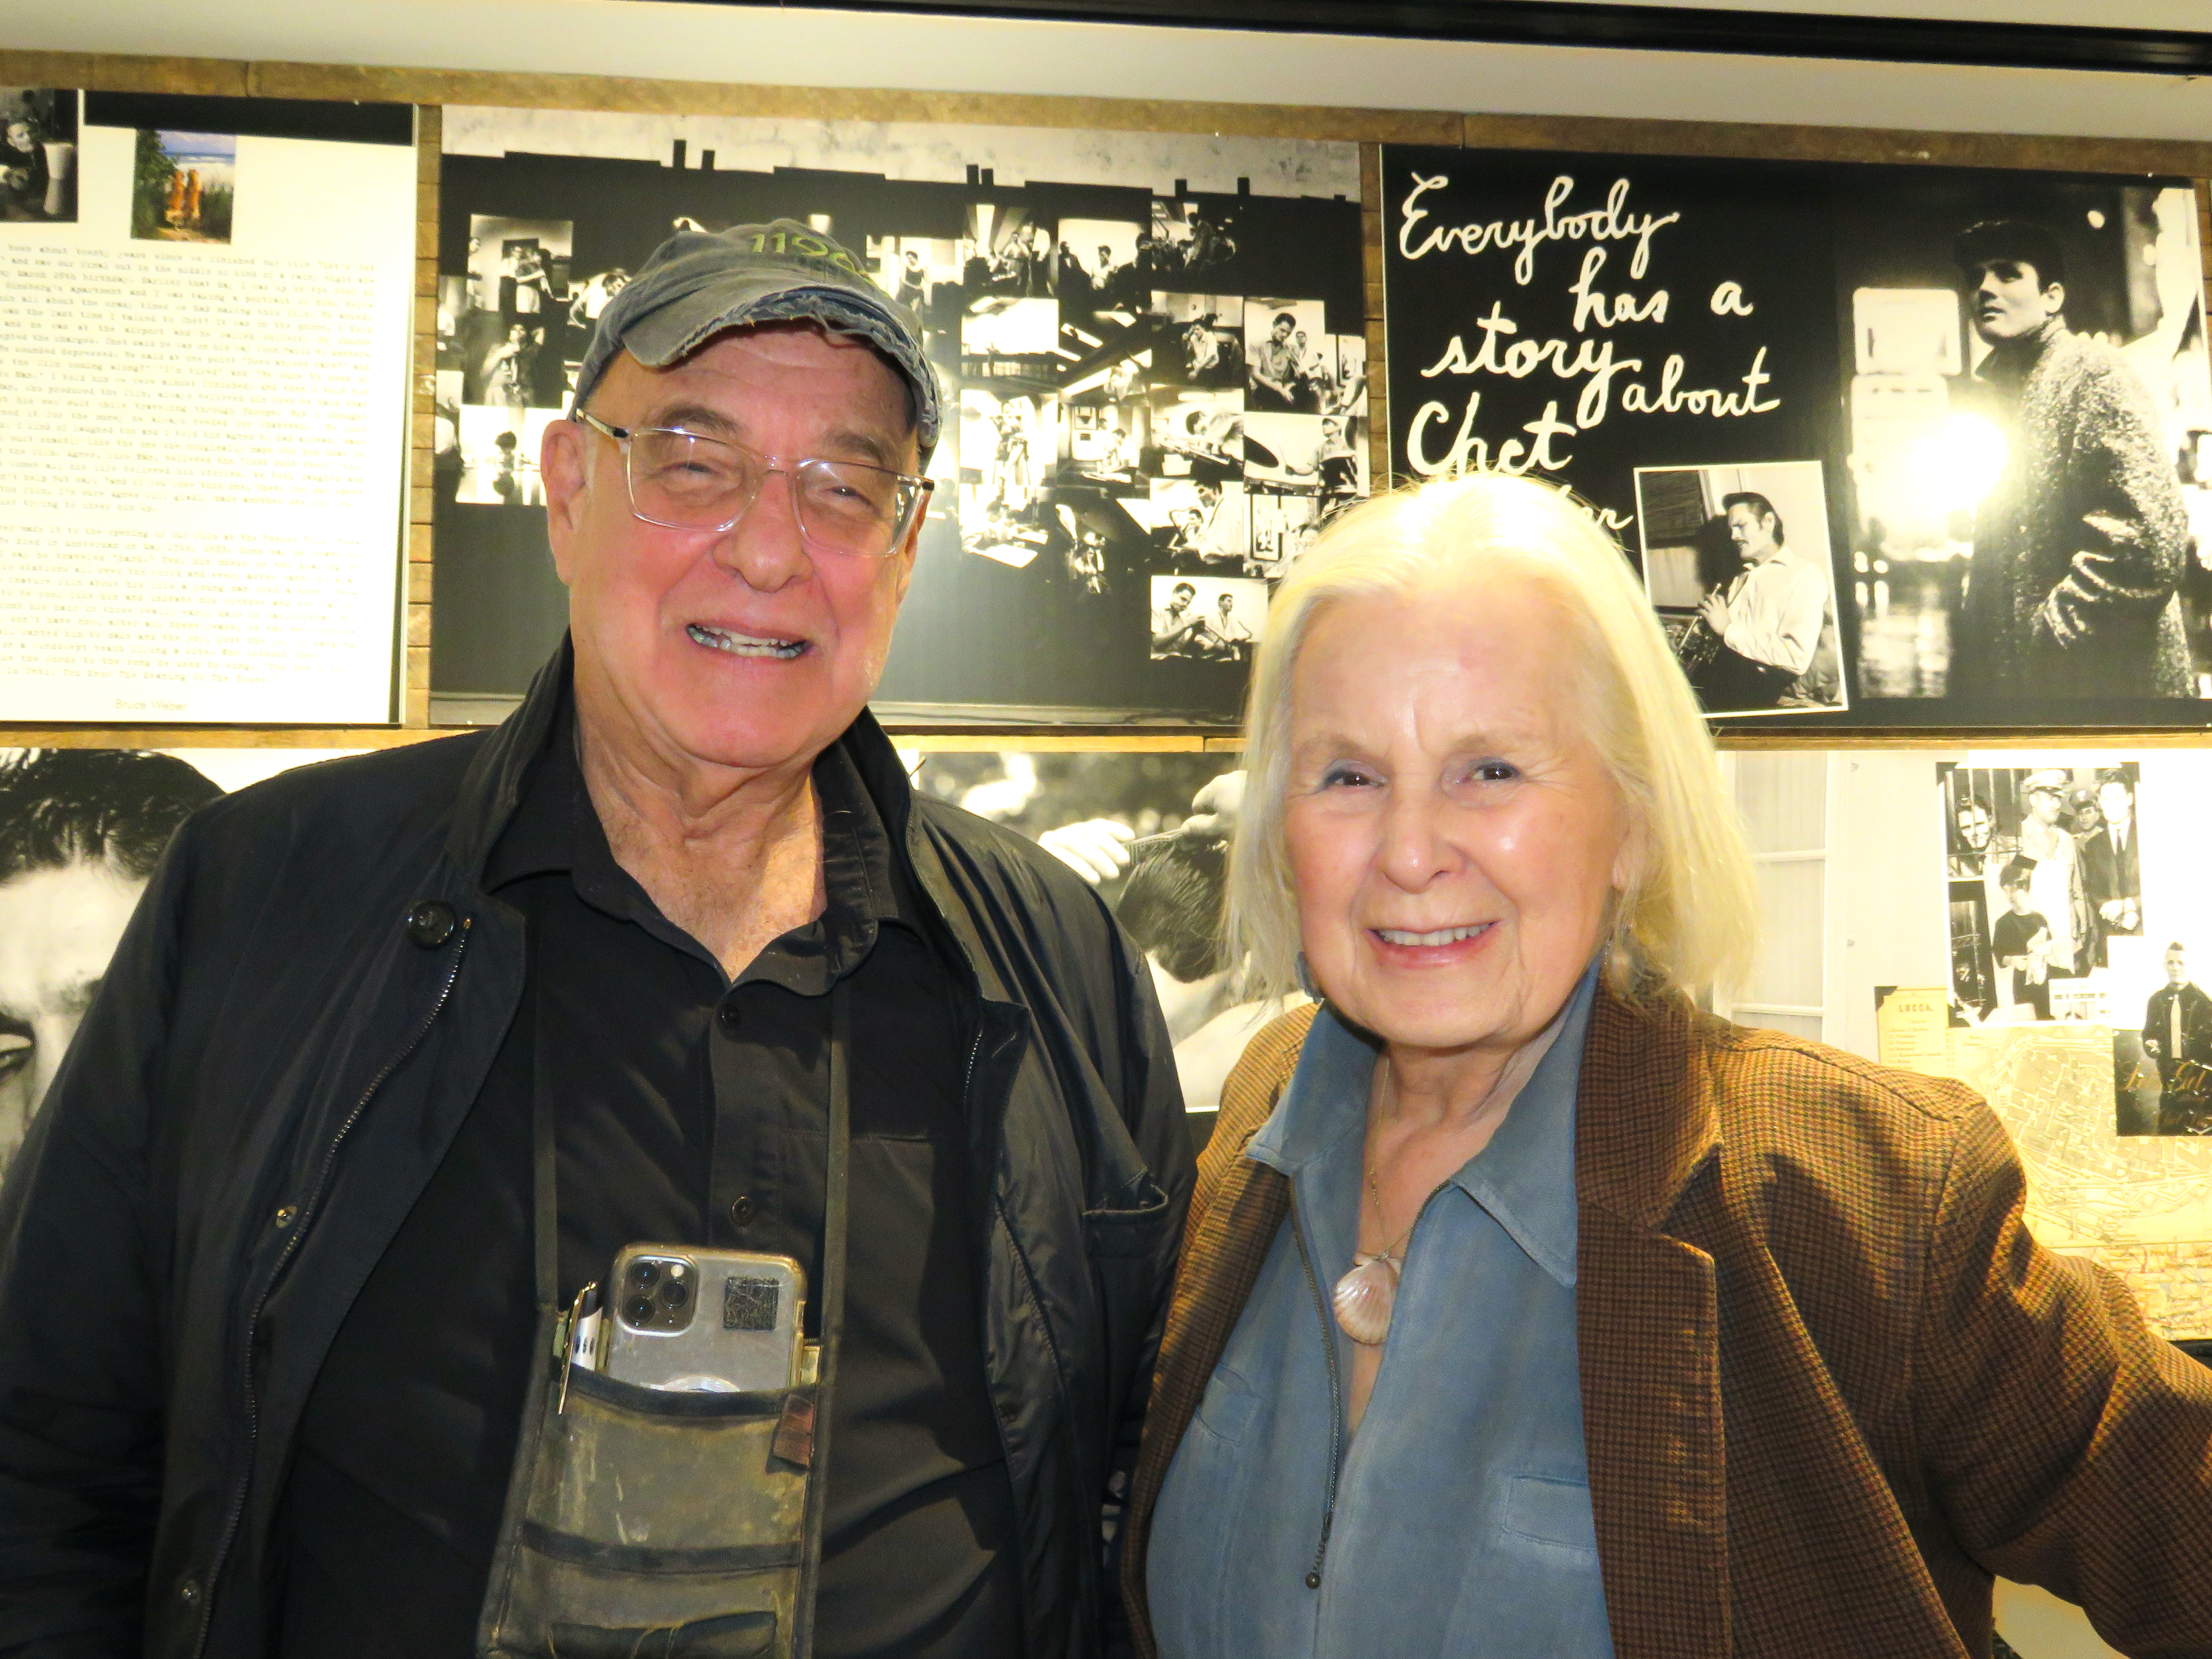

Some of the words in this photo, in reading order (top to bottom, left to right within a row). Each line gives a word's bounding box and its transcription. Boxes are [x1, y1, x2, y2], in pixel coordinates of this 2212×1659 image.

[1399, 172, 1680, 286] Everybody
[1568, 246, 1669, 332] has
[1710, 281, 1754, 316] a
[1420, 301, 1642, 429] story
[1622, 346, 1780, 417] about
[1406, 391, 1576, 477] Chet
[115, 698, 145, 709] Bruce
[151, 699, 186, 710] Weber
